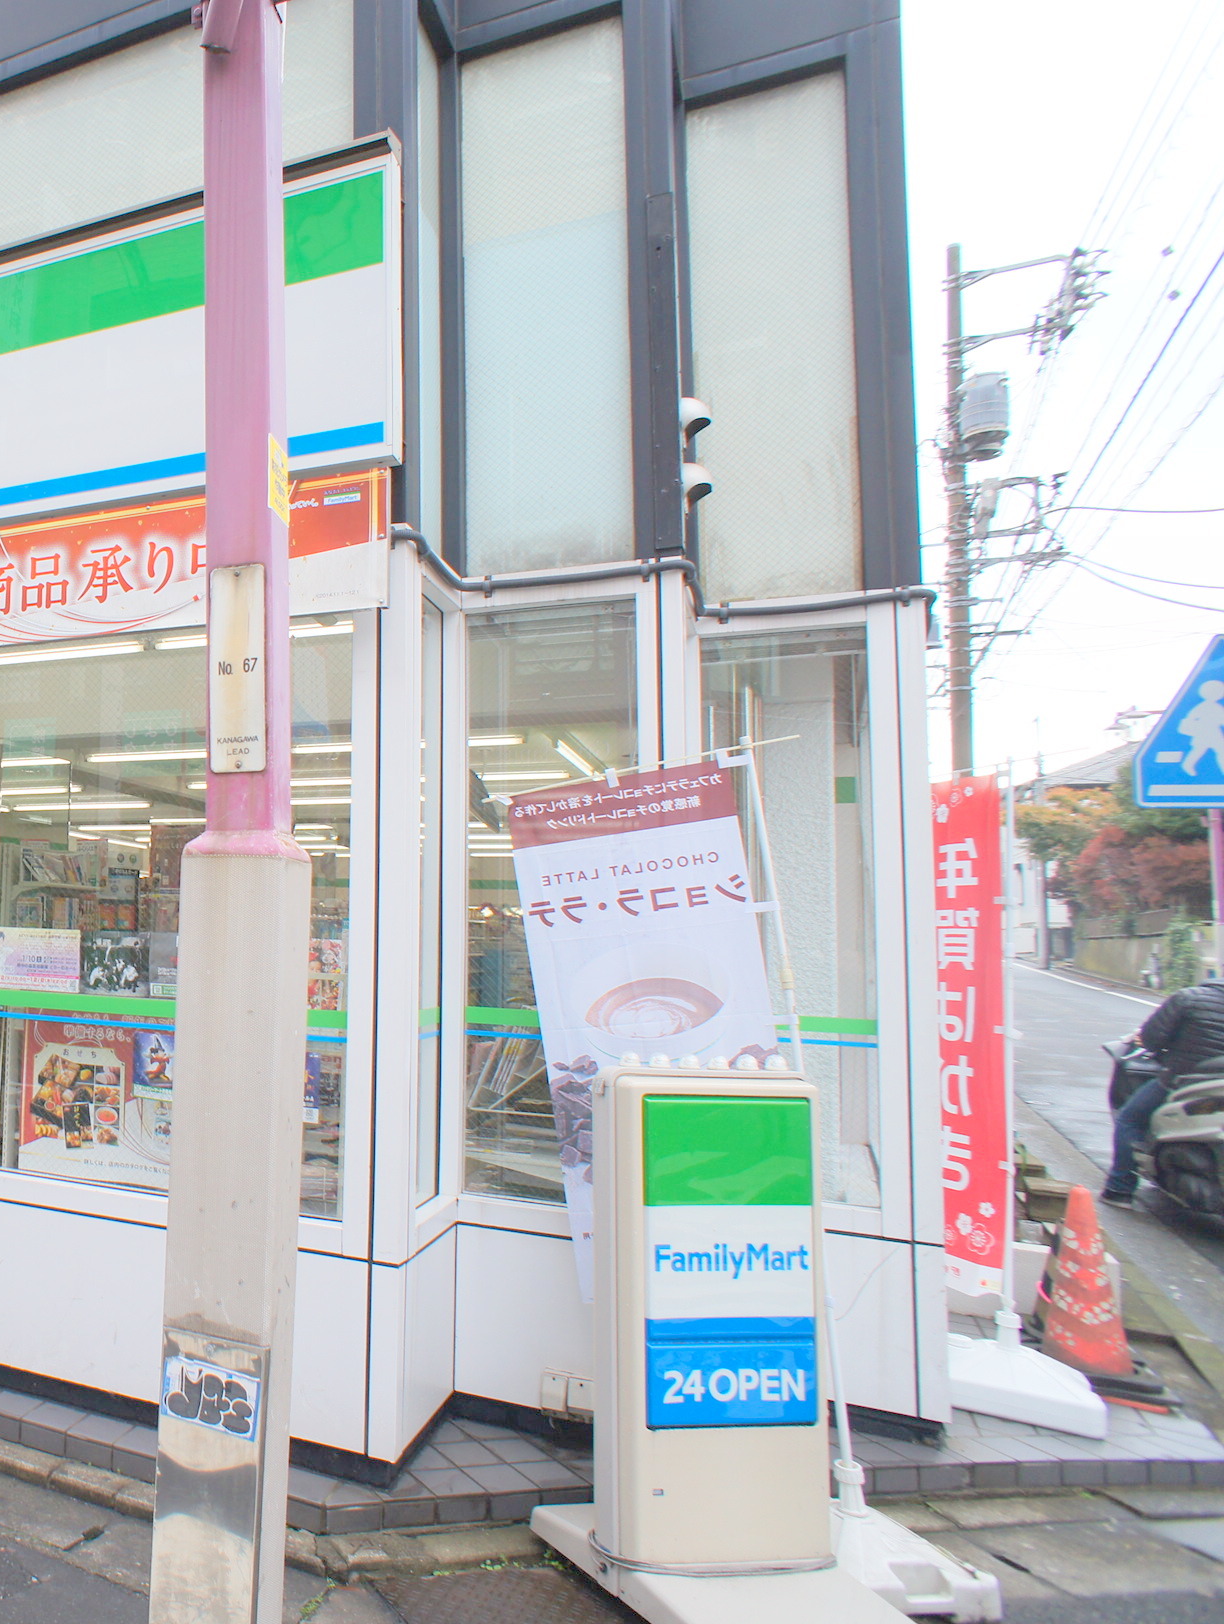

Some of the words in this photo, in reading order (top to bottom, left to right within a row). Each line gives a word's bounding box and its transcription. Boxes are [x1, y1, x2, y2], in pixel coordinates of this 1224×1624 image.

[327, 494, 358, 504] FamilyMart
[242, 657, 258, 673] 67
[217, 734, 259, 745] KANAGAWA
[226, 747, 250, 756] LEAD
[63, 1047, 97, 1059] おせち
[654, 1243, 809, 1280] FamilyMart
